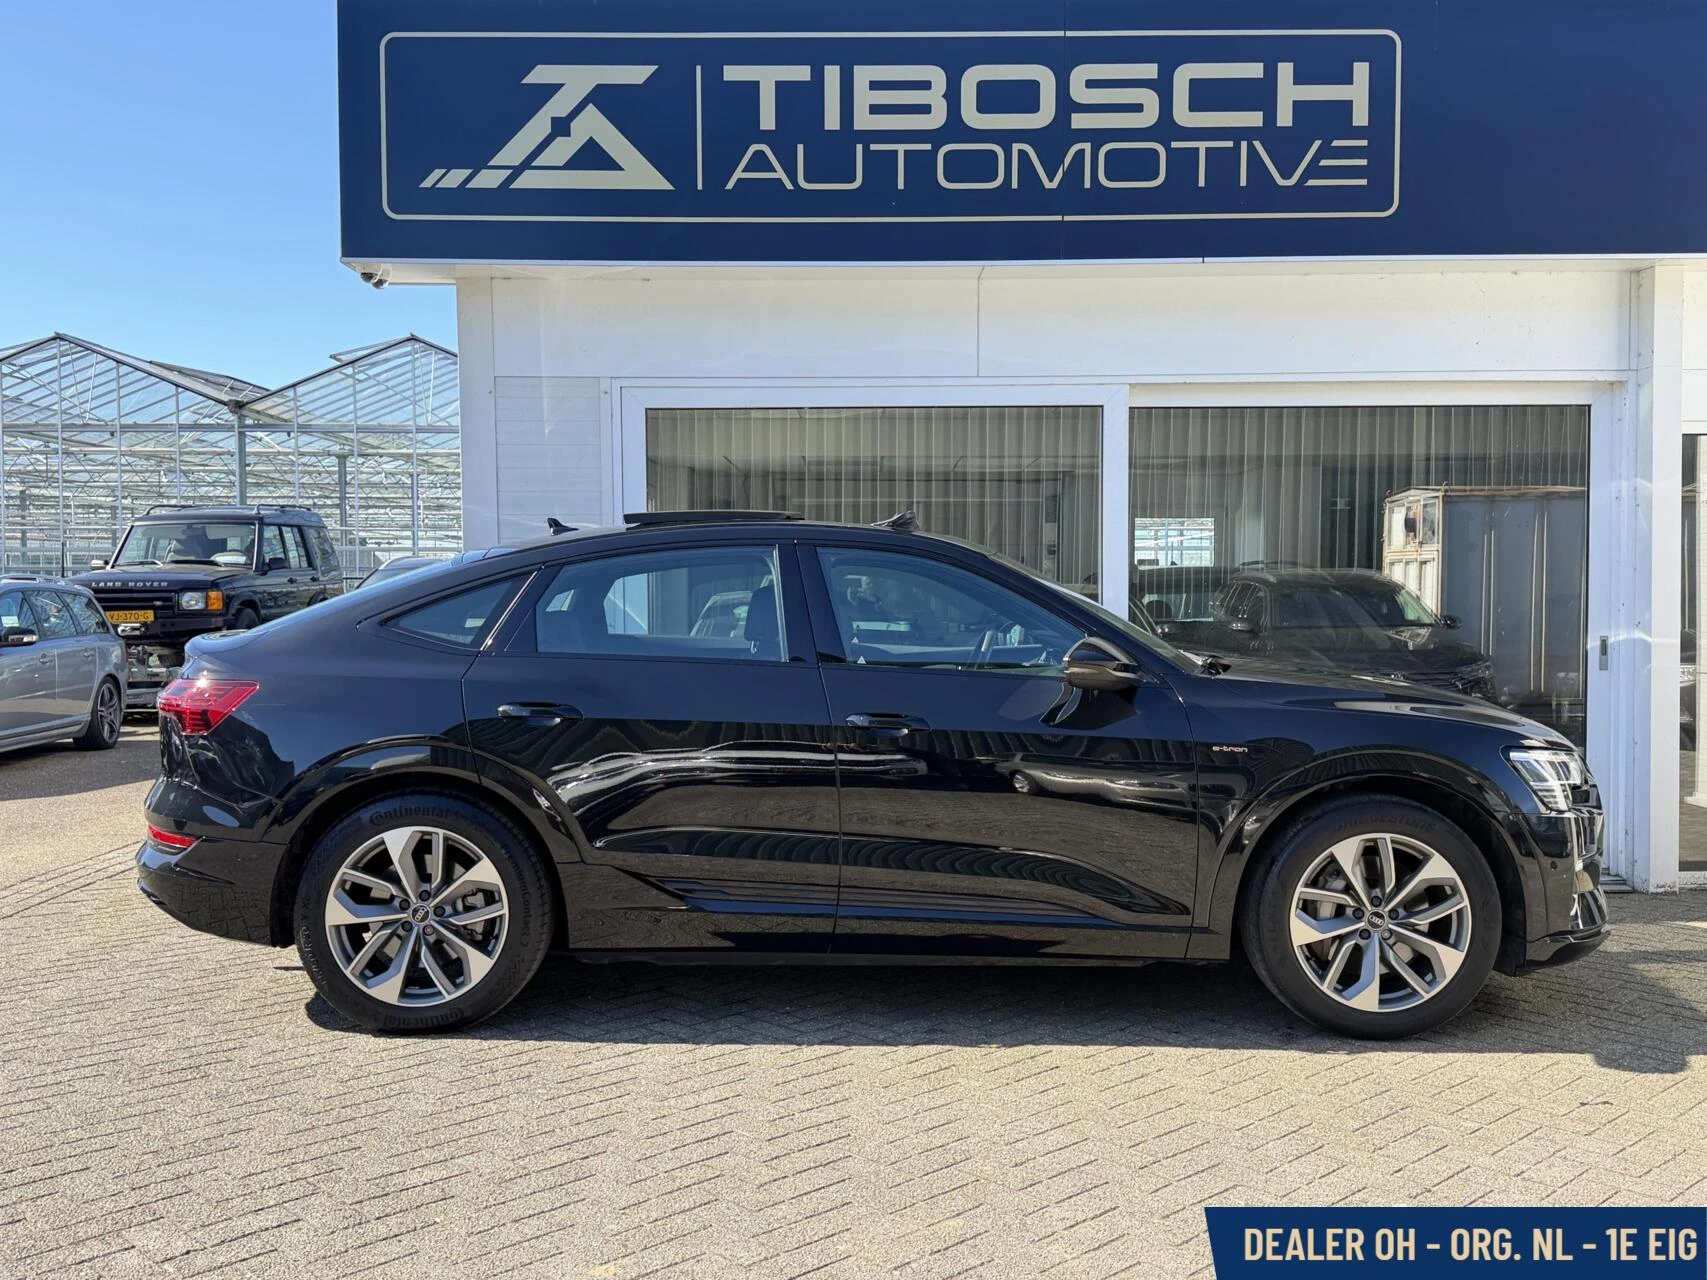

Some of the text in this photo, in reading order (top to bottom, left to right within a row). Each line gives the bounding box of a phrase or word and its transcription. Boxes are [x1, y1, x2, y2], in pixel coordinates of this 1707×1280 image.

[723, 61, 1370, 131] TIBOSCH
[725, 139, 1368, 191] AUTOMOTIVE
[1212, 745, 1249, 753] e-tron
[370, 805, 450, 826] Continental
